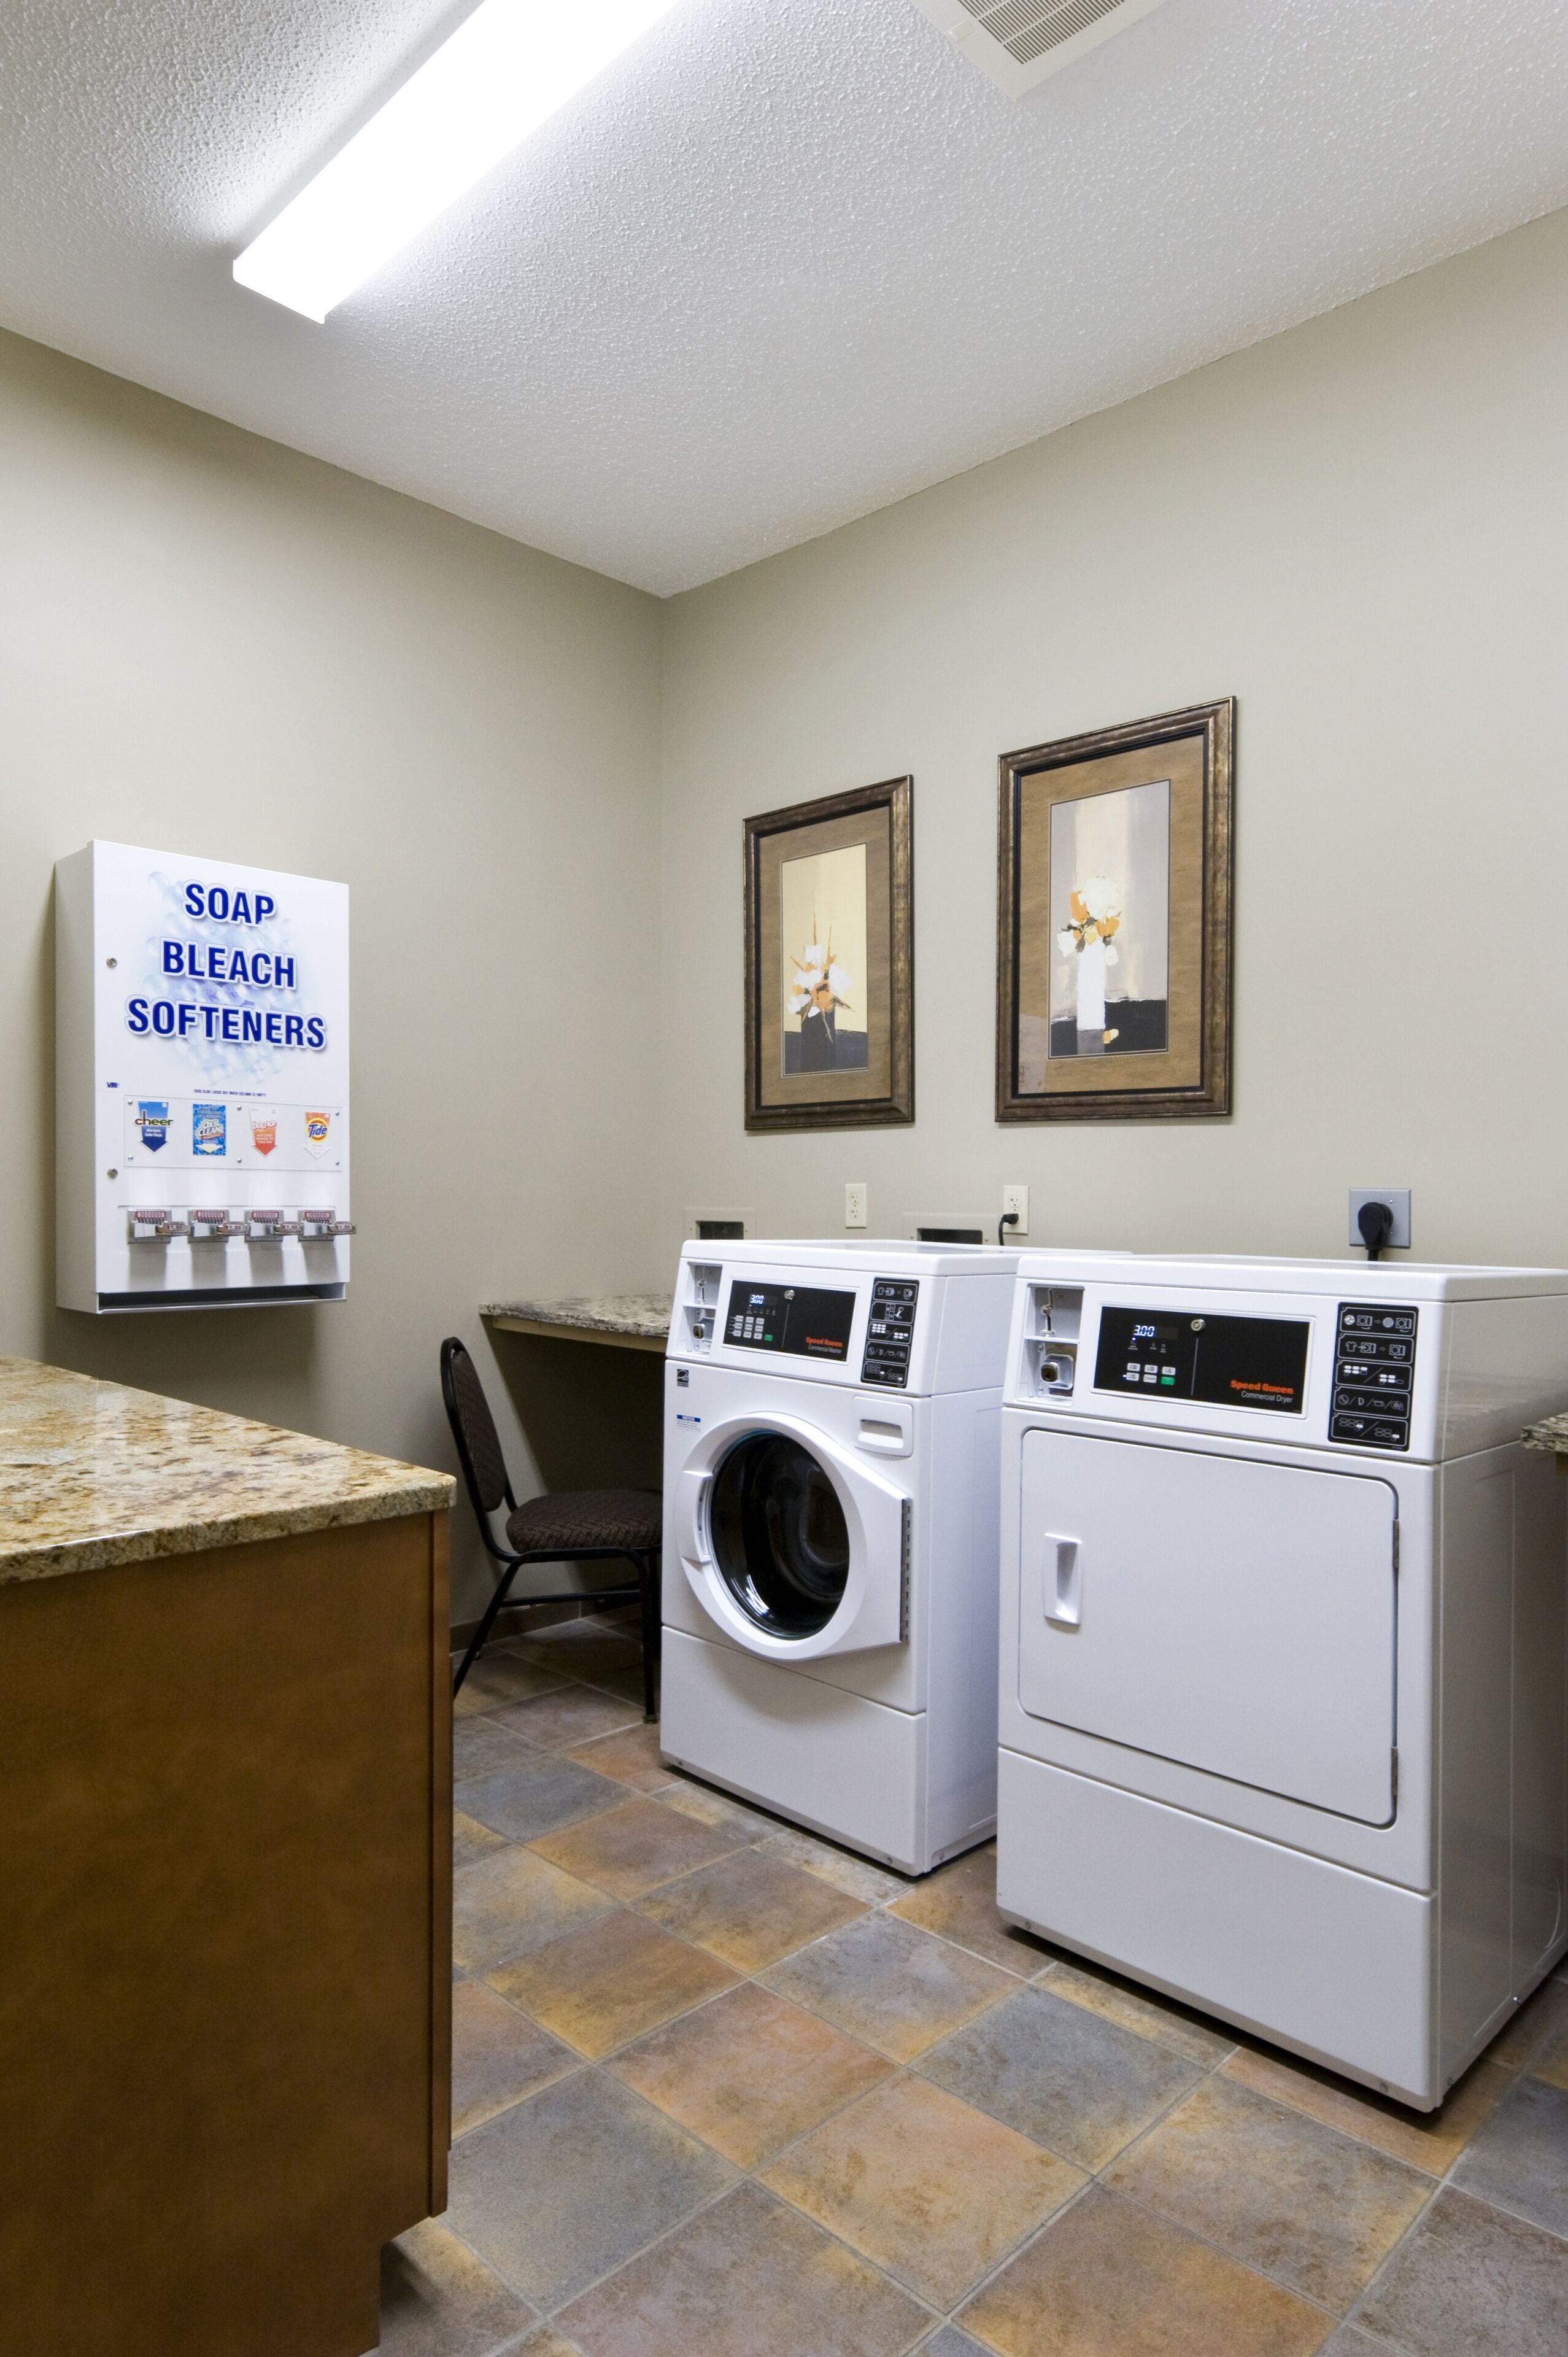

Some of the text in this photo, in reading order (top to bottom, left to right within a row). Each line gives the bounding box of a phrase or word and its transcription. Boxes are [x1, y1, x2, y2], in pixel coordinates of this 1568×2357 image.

[185, 883, 274, 924] SOAP
[163, 940, 295, 988] BLEACH
[128, 998, 325, 1048] SOFTENERS
[134, 1110, 174, 1126] cheer
[203, 1120, 217, 1129] OXI
[309, 1124, 327, 1137] Tide
[1230, 1380, 1294, 1394] Speed Queen
[1241, 1390, 1294, 1404] Commercial Dryer
